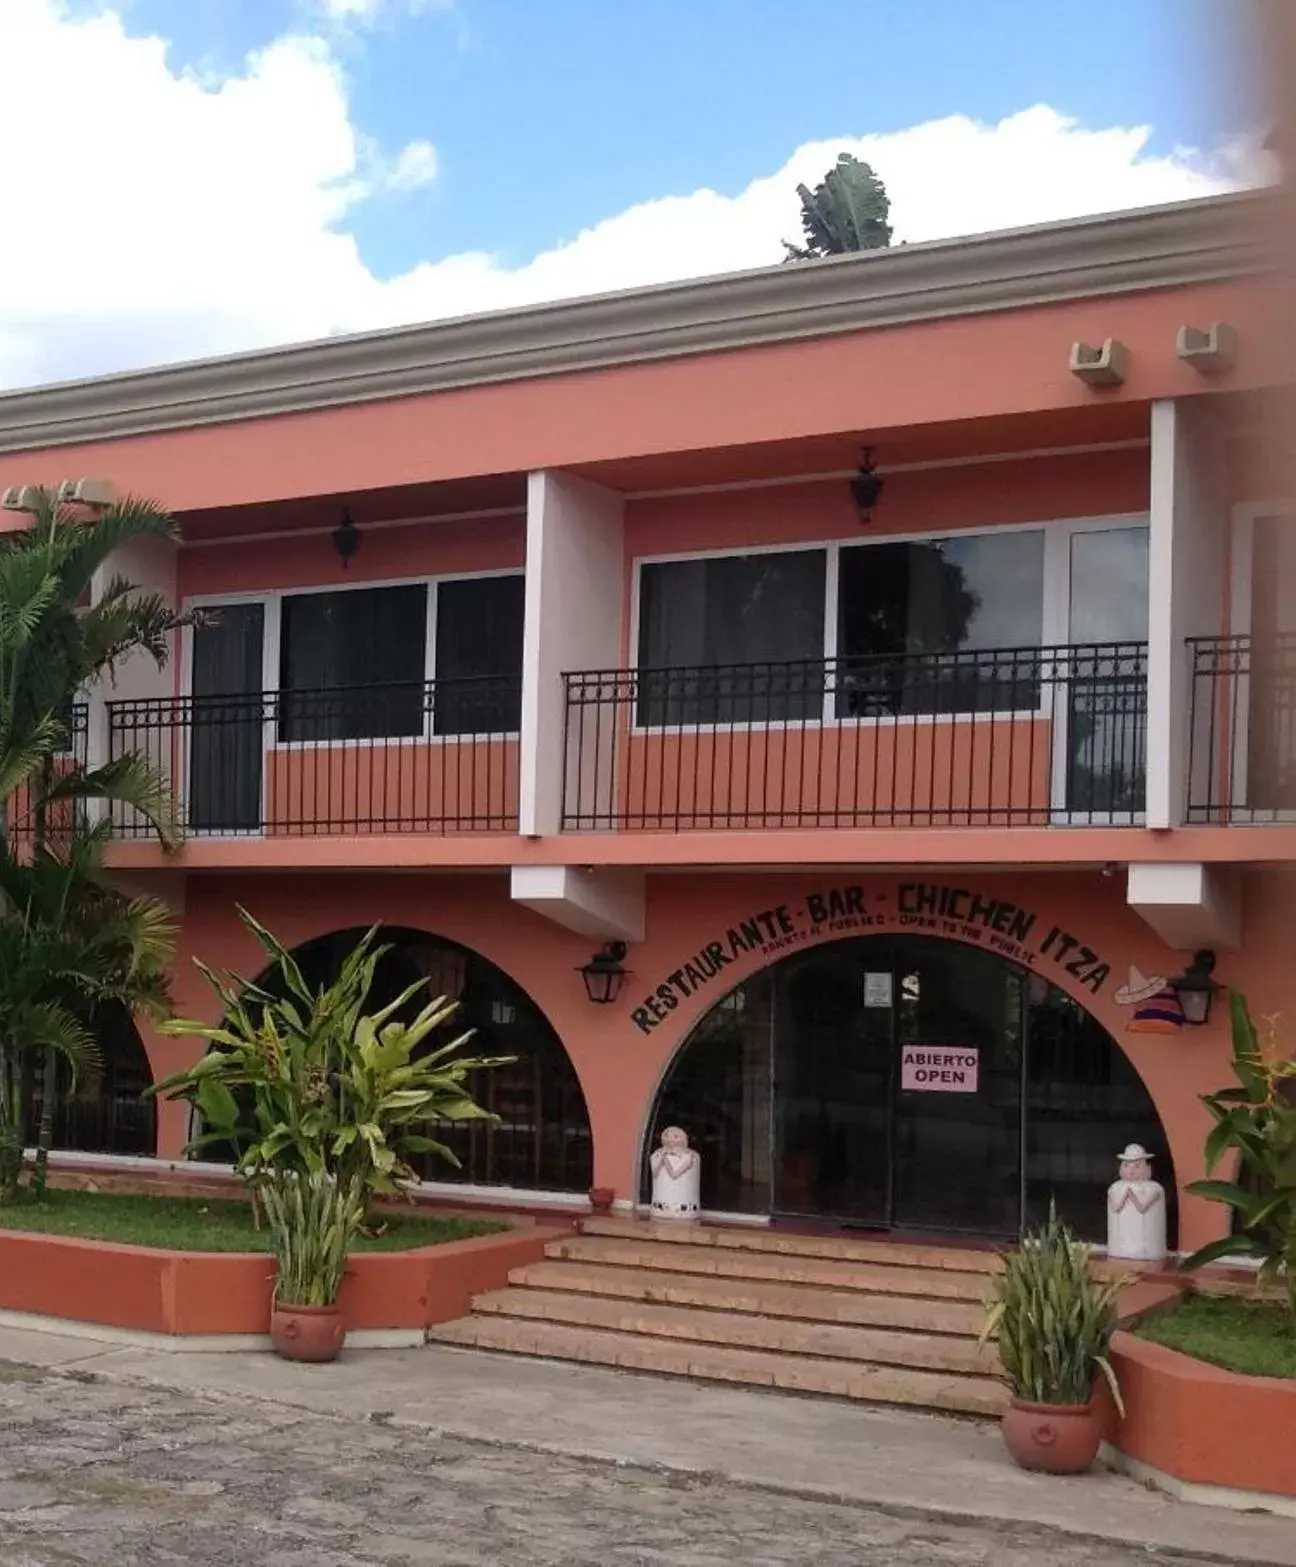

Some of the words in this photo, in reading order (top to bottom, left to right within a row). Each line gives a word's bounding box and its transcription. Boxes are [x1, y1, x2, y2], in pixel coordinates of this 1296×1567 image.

[630, 904, 795, 1036] RESTAURANTE
[805, 885, 868, 924] BAR
[898, 883, 1037, 943] CHICHEN
[1040, 926, 1111, 996] ITZA
[904, 1053, 977, 1068] ABIERTO
[914, 1068, 966, 1084] OPEN
